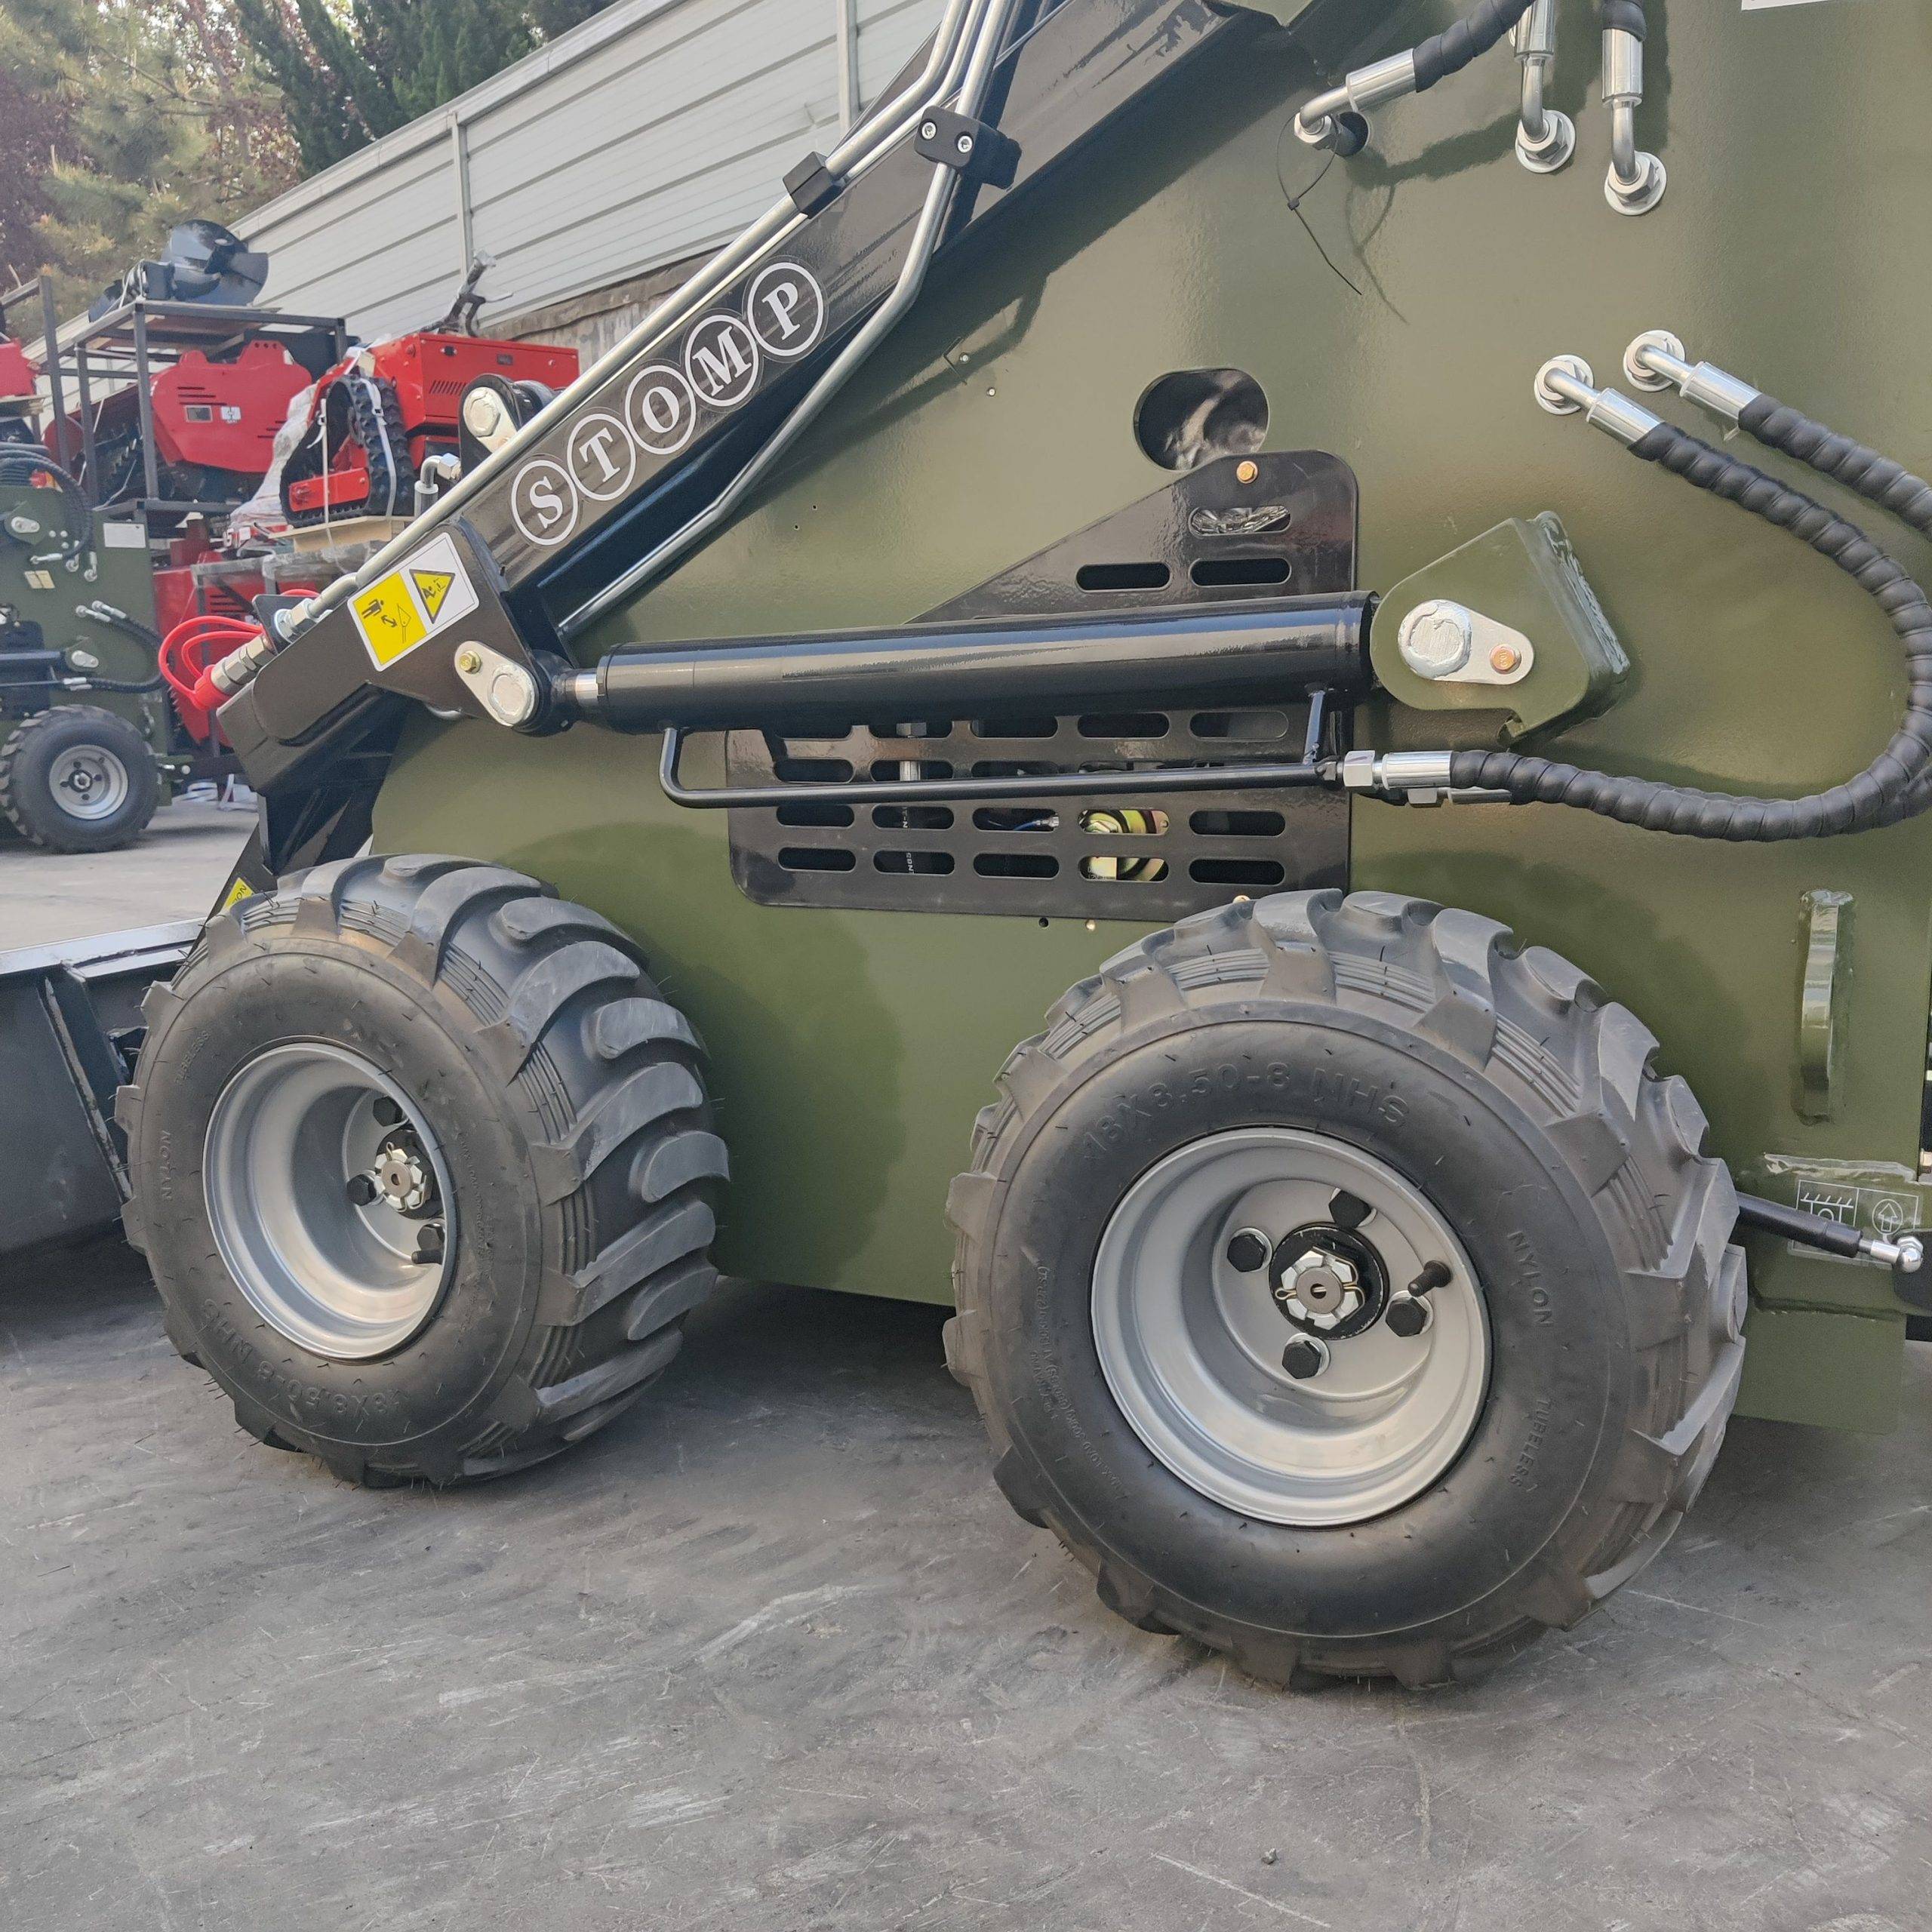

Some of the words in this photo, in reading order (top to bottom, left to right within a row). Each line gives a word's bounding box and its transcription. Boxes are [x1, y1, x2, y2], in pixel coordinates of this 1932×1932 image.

[526, 280, 804, 531] STOMP
[174, 1029, 211, 1088] TUBELESS
[1081, 1060, 1291, 1152] 18X8.50-8
[1311, 1067, 1413, 1128] NHS
[158, 1129, 172, 1201] NYLON
[1506, 1229, 1554, 1326] NYLON
[1507, 1398, 1555, 1488] TUBELESS
